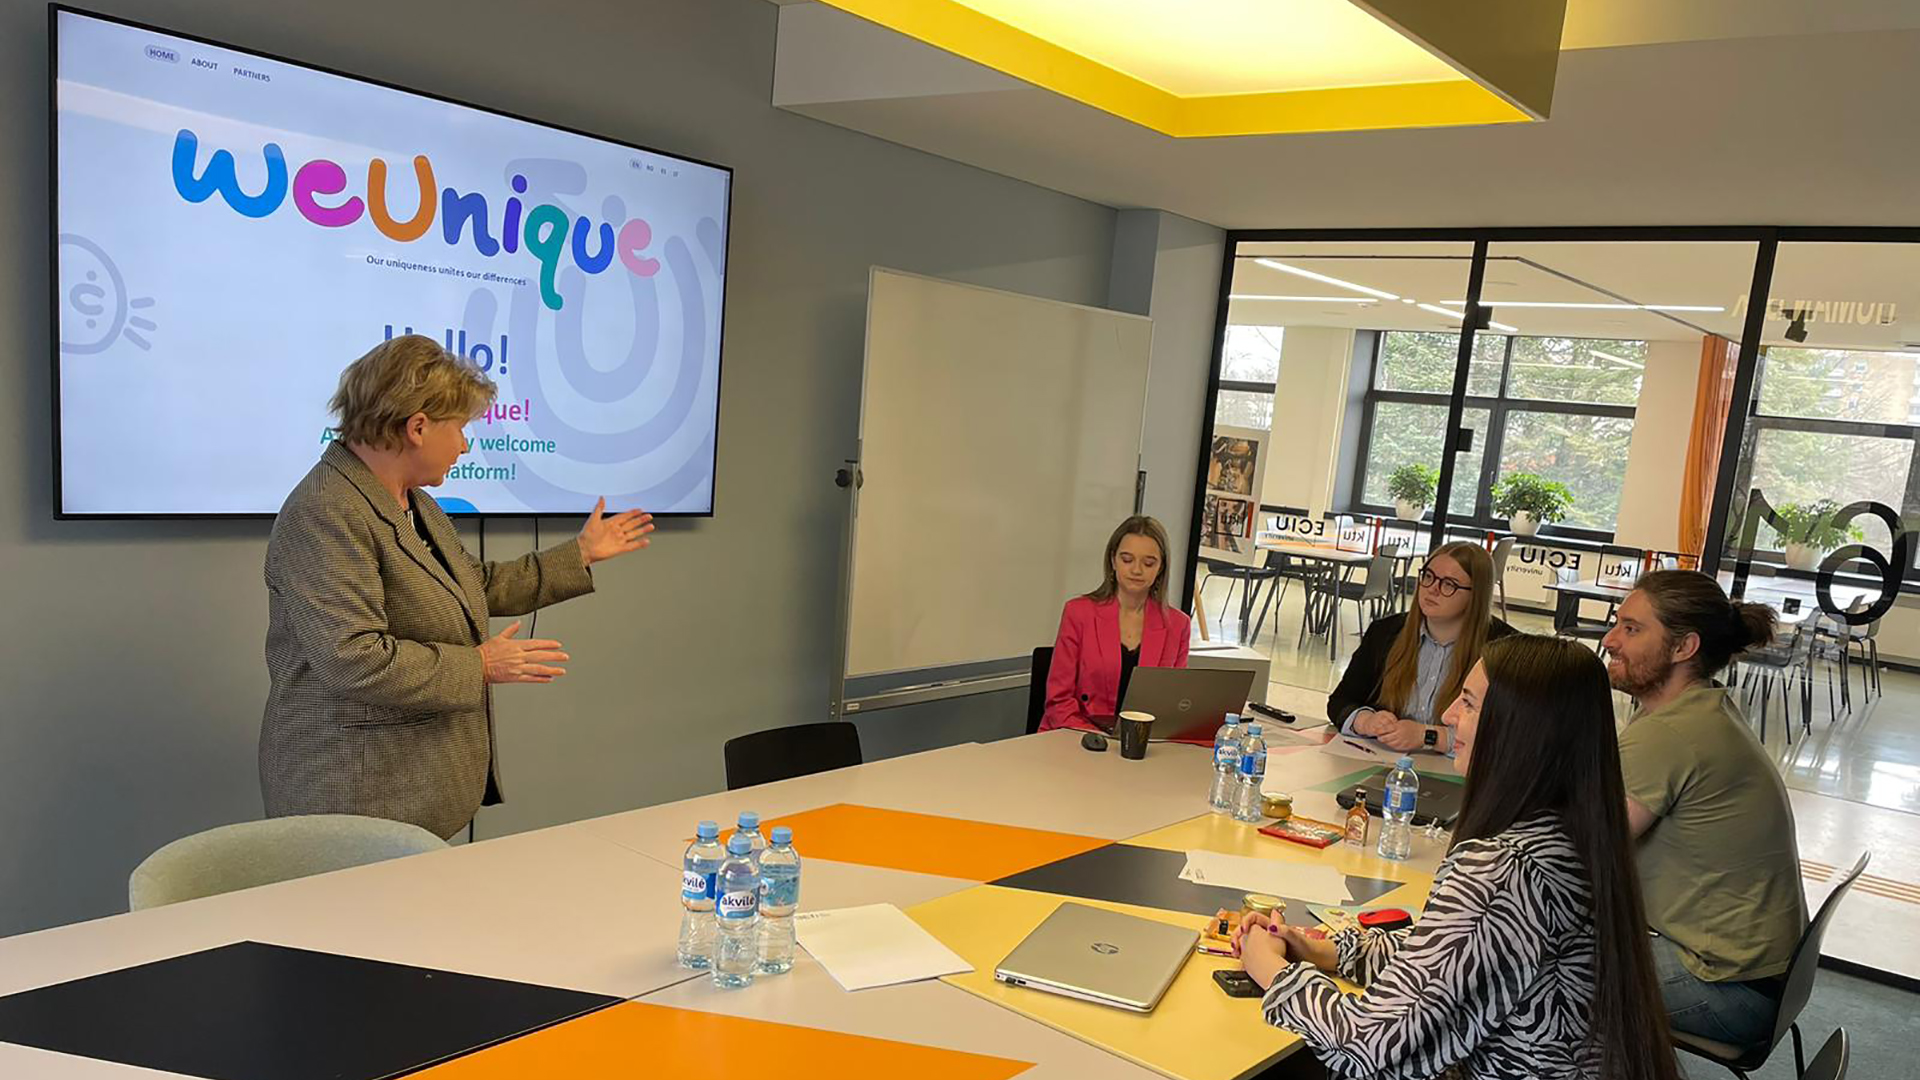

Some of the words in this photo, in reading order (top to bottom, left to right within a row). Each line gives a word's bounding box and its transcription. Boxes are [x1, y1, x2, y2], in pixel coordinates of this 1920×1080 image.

[149, 48, 175, 61] HOME
[191, 58, 218, 71] ABOUT
[233, 67, 271, 82] PARTNERS
[366, 254, 384, 265] Our
[386, 258, 437, 273] uniqueness
[438, 266, 465, 277] unites
[466, 271, 481, 280] our
[482, 272, 527, 286] differences
[480, 434, 556, 453] welcome
[446, 462, 516, 480] atform!
